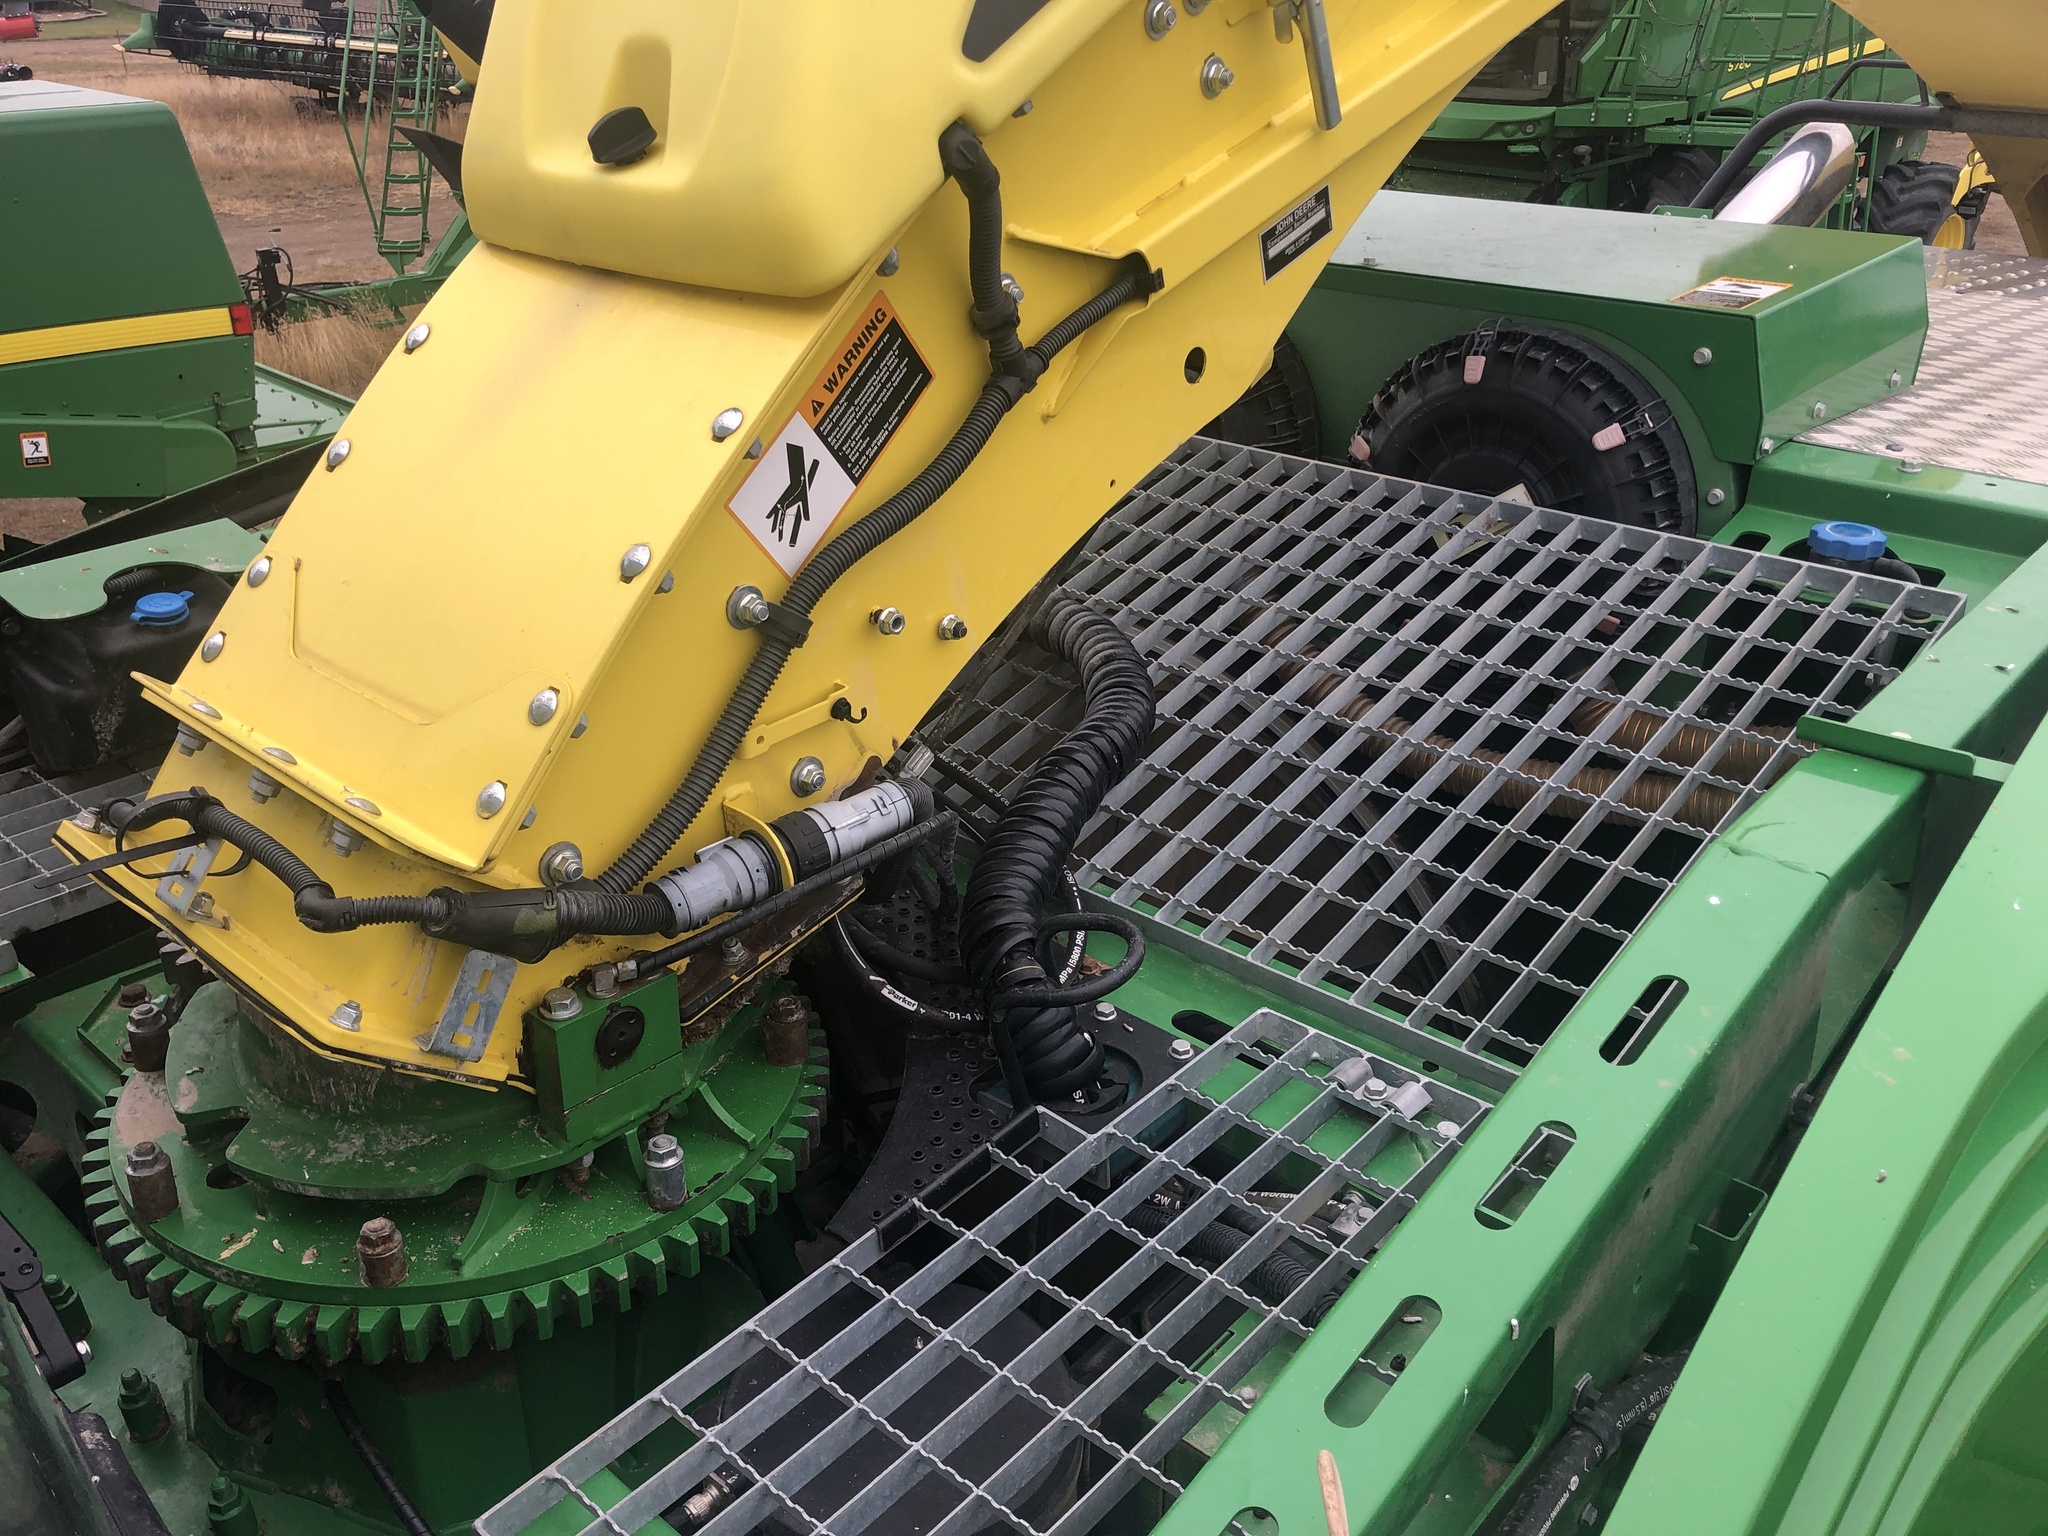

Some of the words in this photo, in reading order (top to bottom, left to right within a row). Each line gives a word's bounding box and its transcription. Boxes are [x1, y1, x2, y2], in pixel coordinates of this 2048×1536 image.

[1274, 213, 1293, 234] JOHN
[1294, 196, 1316, 220] DEERE
[823, 308, 888, 394] WARNING
[819, 417, 829, 431] Avoid
[828, 403, 840, 419] bodily
[838, 386, 851, 405] injuries
[850, 375, 859, 388] from
[858, 355, 873, 377] hydraulic
[827, 425, 839, 442] Before
[853, 373, 876, 405] disassembling
[878, 349, 893, 369] charging
[891, 336, 902, 351] spout
[833, 417, 856, 450] disassembling
[880, 370, 889, 383] valve
[835, 410, 856, 439] accumulator
[858, 384, 874, 406] removing
[872, 365, 888, 386] hydraulic
[886, 354, 895, 366] lines
[842, 438, 851, 451] Start
[850, 423, 862, 440] engine
[867, 402, 877, 416] press
[875, 387, 887, 403] switch
[890, 367, 901, 382] spout
[899, 356, 908, 369] down
[854, 421, 868, 441] seconds
[881, 385, 894, 403] system
[892, 366, 907, 387] hydraulic
[822, 420, 833, 435] under
[847, 437, 863, 459] pressure
[850, 450, 860, 463] Stop
[858, 435, 870, 452] engine
[851, 463, 859, 474] Use
[858, 453, 866, 465] only
[870, 427, 885, 448] nitrogen
[887, 398, 905, 423] recharging
[854, 467, 862, 478] See
[860, 457, 869, 469] your
[867, 444, 878, 459] JOHN
[876, 429, 888, 446] DEERE
[886, 987, 917, 1008] Parker
[1058, 966, 1073, 984] MPa
